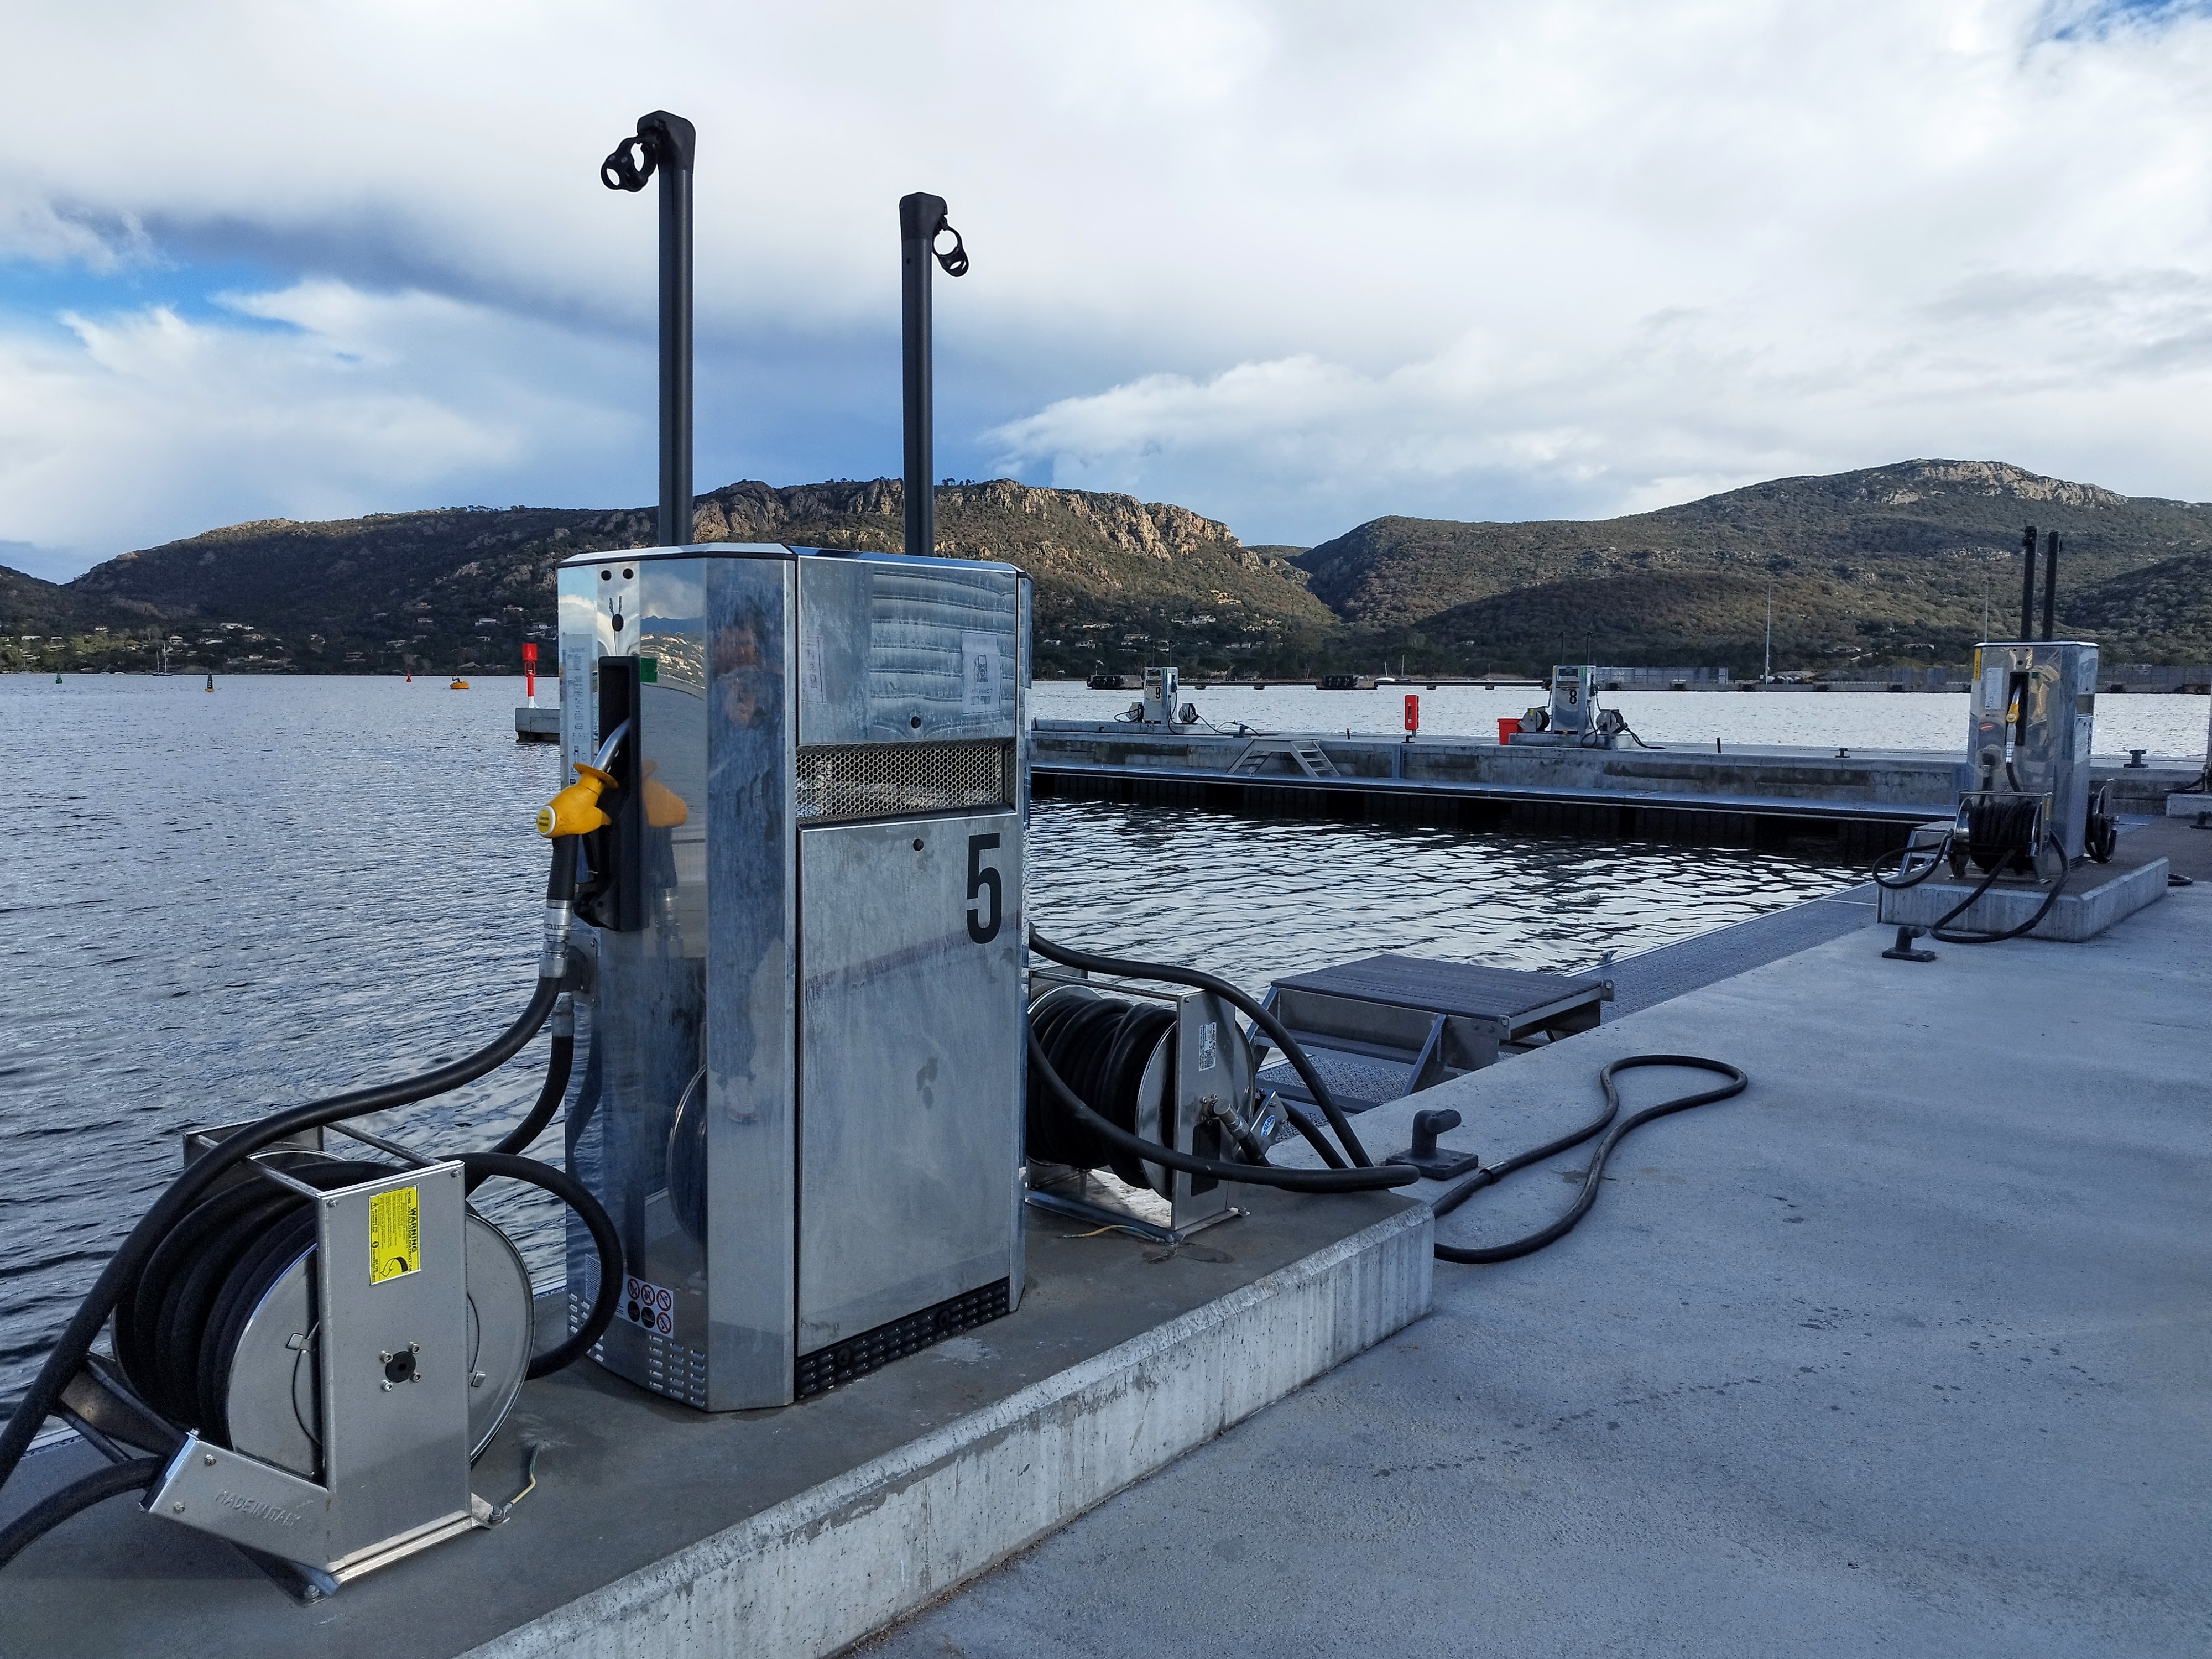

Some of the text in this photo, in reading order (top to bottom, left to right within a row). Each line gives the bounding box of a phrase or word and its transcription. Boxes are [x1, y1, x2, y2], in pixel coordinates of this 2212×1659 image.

[1155, 687, 1161, 699] 9
[1569, 689, 1577, 705] 8
[966, 832, 1003, 945] 5
[215, 1489, 254, 1512] MADE
[264, 1506, 301, 1527] ITALY
